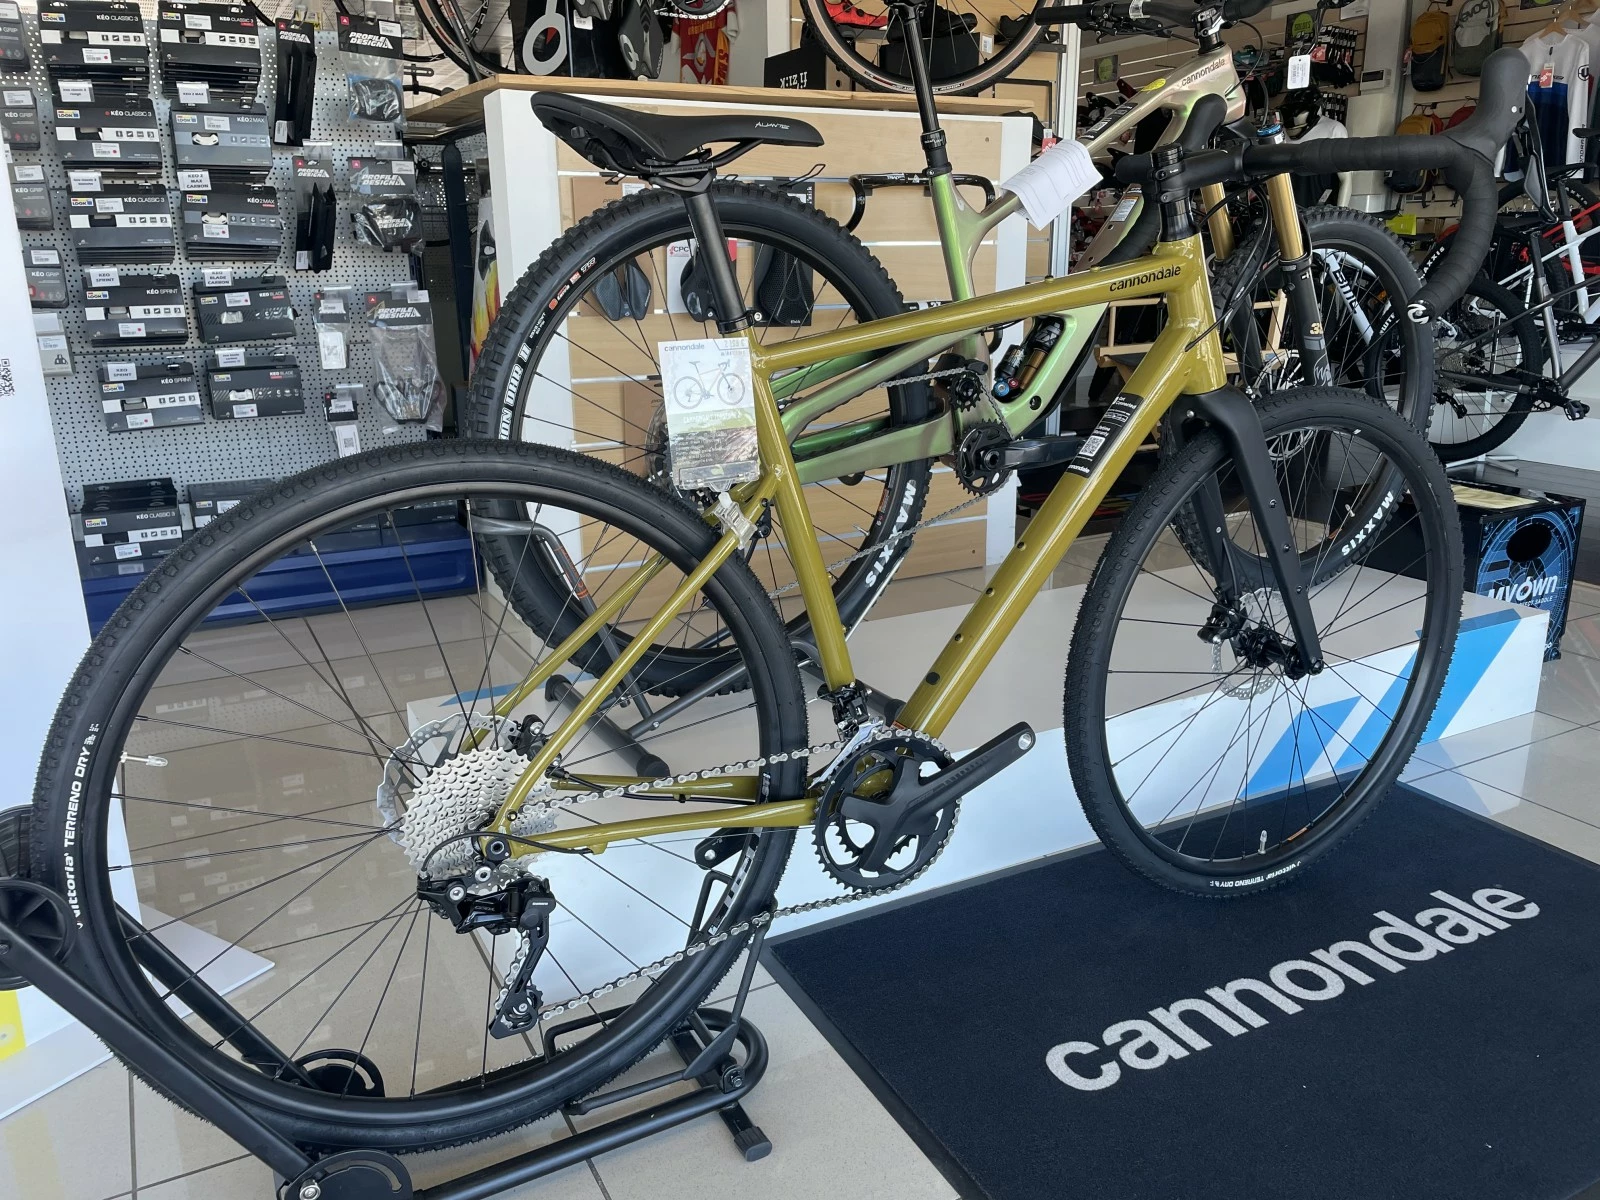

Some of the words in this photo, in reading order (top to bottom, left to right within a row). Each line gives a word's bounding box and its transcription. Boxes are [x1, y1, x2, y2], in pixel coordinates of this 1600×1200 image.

[280, 31, 306, 39] PROFILE
[349, 32, 386, 43] PROFILE
[350, 38, 386, 48] DESIGN
[1181, 58, 1225, 87] cannondale
[1109, 264, 1181, 292] cannondale
[664, 342, 705, 352] cannondale
[1341, 490, 1394, 556] MAXXIS
[64, 781, 82, 848] TERRENO
[74, 746, 91, 778] DRY
[1045, 887, 1540, 1092] cannondale
